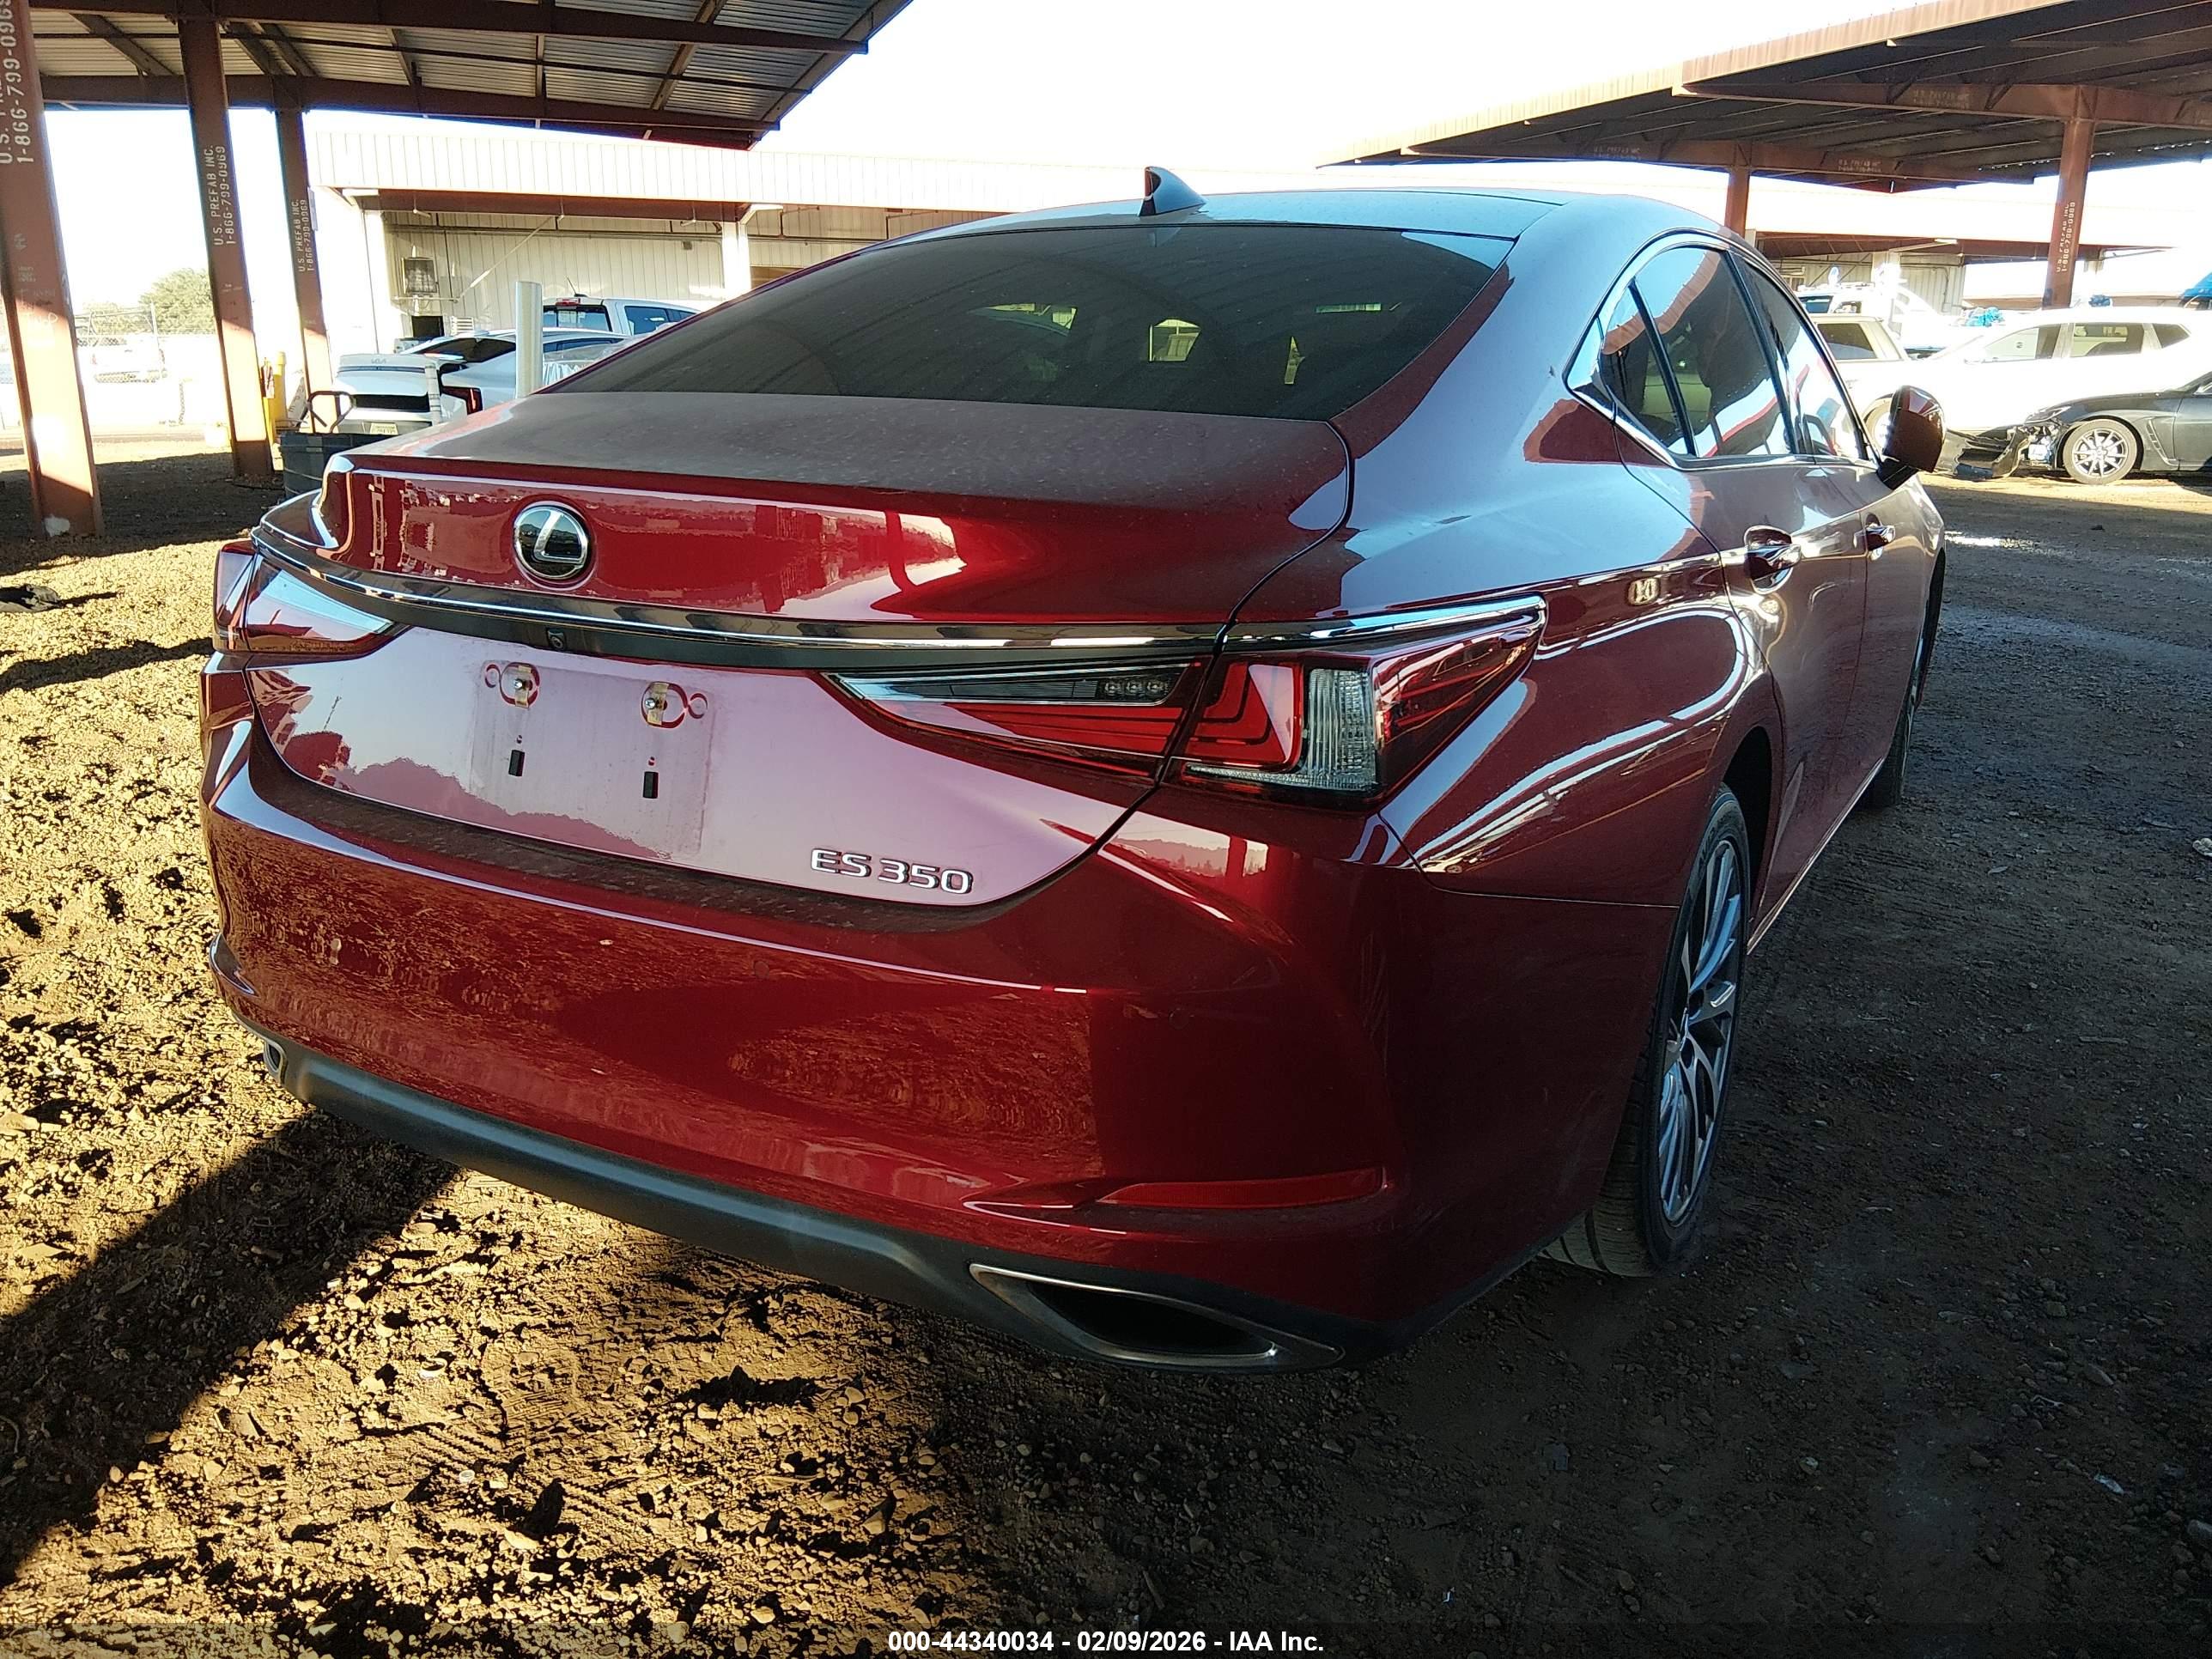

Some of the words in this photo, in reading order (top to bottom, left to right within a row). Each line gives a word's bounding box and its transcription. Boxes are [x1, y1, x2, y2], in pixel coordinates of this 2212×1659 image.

[204, 144, 215, 167] INC.
[206, 173, 222, 217] PREFAB
[215, 145, 236, 245] 1-866-799-0969
[212, 223, 224, 246] U.S.
[295, 219, 303, 251] PREFAB
[811, 848, 872, 878] ES
[878, 857, 974, 895] 350
